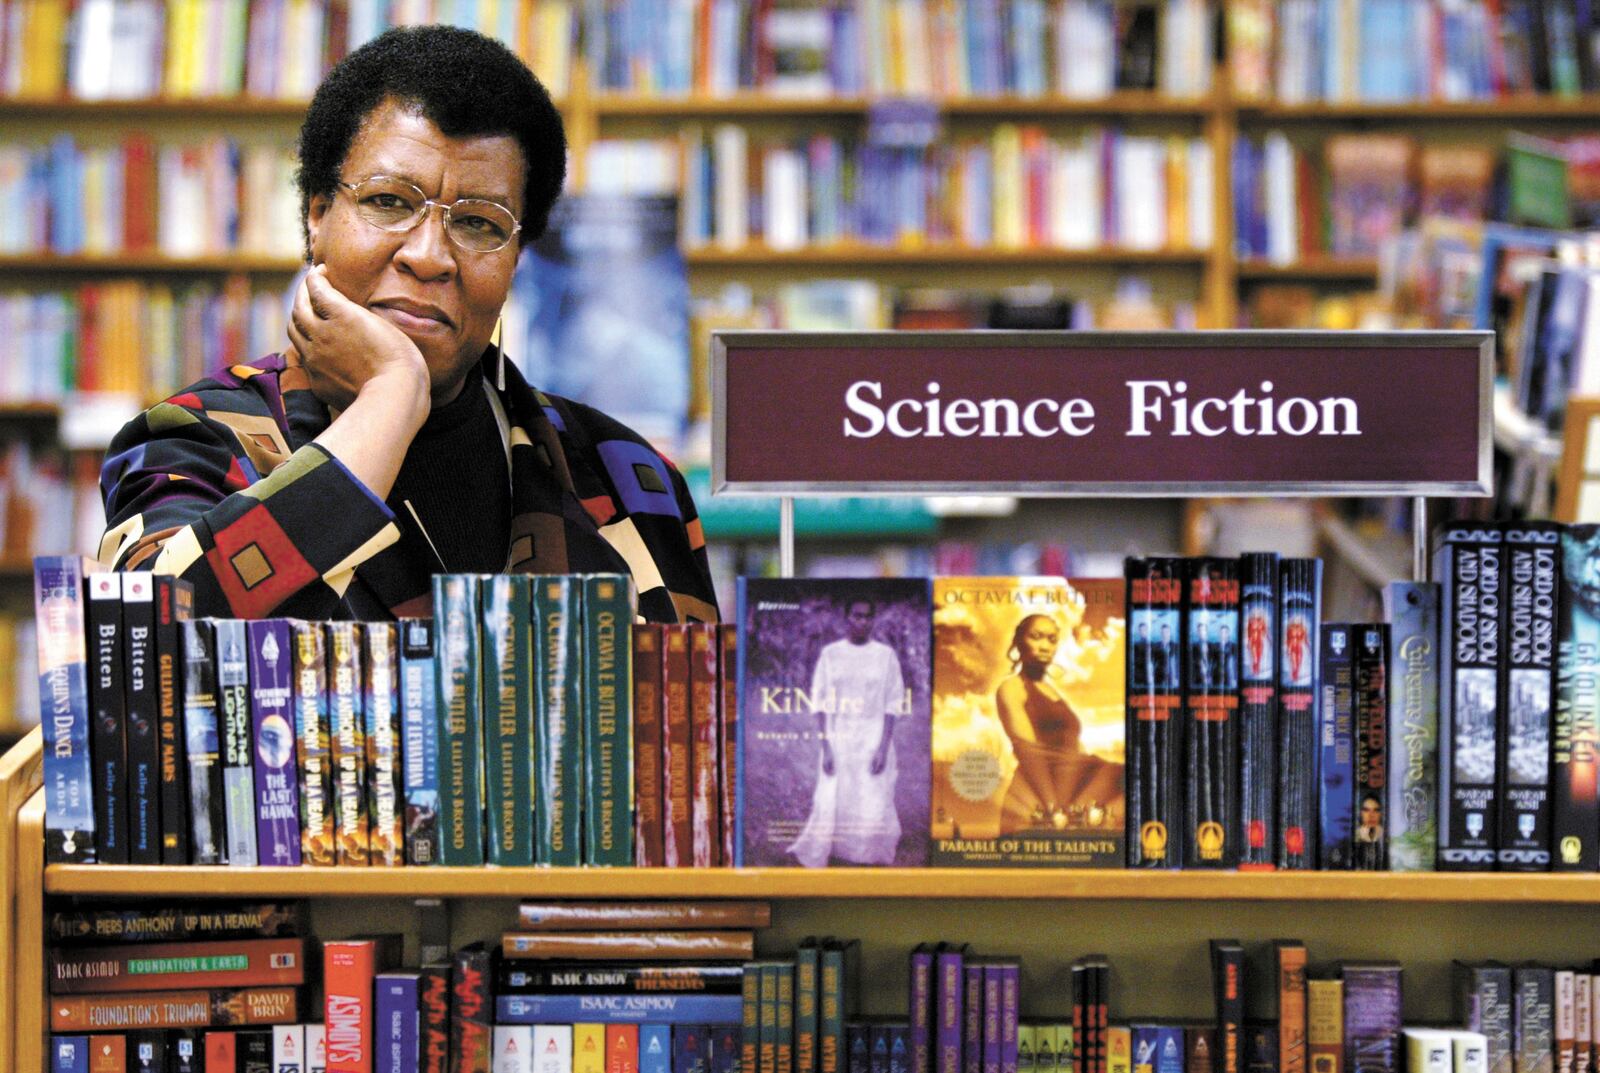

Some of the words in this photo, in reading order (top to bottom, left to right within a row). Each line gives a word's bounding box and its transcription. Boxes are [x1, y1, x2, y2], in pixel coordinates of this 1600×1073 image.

[843, 380, 1096, 437] Science
[1125, 381, 1362, 436] Fiction
[1457, 550, 1478, 583] AND
[1479, 548, 1499, 593] LORD
[1512, 550, 1533, 583] AND
[1533, 548, 1555, 594] LORD
[943, 590, 1025, 605] OCTAVIA
[1046, 590, 1114, 605] BUTLER
[1479, 594, 1499, 618] OF
[1532, 594, 1554, 619] OF
[598, 612, 615, 671] OCTAVIA
[1456, 583, 1478, 664] SHADOWS
[1478, 617, 1498, 665] SNOW
[1511, 583, 1532, 664] SHADOWS
[1531, 618, 1553, 666] SNOW
[99, 624, 116, 689] Bitten
[131, 626, 148, 691] Bitten
[1400, 635, 1431, 721] Catherine
[1557, 641, 1574, 690] NEAL
[160, 654, 173, 717] GULLIVAR
[162, 722, 174, 739] OF
[224, 689, 238, 763] LIGHTNING
[234, 686, 247, 735] CATCH
[408, 709, 423, 724] OF
[500, 685, 516, 736] BUTLER
[599, 685, 616, 736] BUTLER
[1554, 699, 1571, 763] ASHER
[54, 715, 74, 758] DANCE
[237, 737, 248, 765] THE
[1402, 719, 1431, 781] Asaro
[163, 744, 176, 783] MARS
[265, 773, 287, 789] THE
[305, 759, 321, 773] UP
[340, 756, 356, 771] UP
[56, 771, 66, 816] ARDEN
[70, 779, 79, 807] TOM
[260, 804, 295, 819] HAWK
[262, 790, 292, 804] LAST
[1463, 799, 1487, 809] ASH
[1516, 799, 1540, 810] ASH
[106, 796, 115, 848] Armstrong
[138, 798, 148, 849] Armstrong
[453, 799, 465, 849] BROOD
[502, 800, 514, 851] BROOD
[552, 800, 564, 850] BROOD
[601, 800, 614, 851] BROOD
[939, 839, 998, 853] PARABLE
[1001, 839, 1020, 852] OF
[1022, 839, 1051, 852] THE
[1054, 839, 1116, 853] TALENTS
[96, 918, 123, 934] PIERS
[125, 916, 175, 933] ANTHONY
[184, 915, 199, 929] UP
[200, 915, 212, 928] IN
[213, 915, 223, 928] A
[57, 962, 83, 979] ISAAC
[84, 960, 120, 977] ASIMOV
[130, 957, 199, 973] FOUNDATION
[200, 957, 208, 970] &
[211, 954, 247, 969] EARTH
[551, 973, 585, 985] ISAAC
[586, 973, 628, 985] ASIMOV
[89, 1005, 159, 1026] FOUNDATION'S
[163, 1003, 208, 1023] TRIUMPH
[247, 992, 290, 1007] DAVID
[252, 1005, 286, 1017] BRIN
[579, 997, 621, 1010] ISAAC
[623, 997, 677, 1010] ASIMOV
